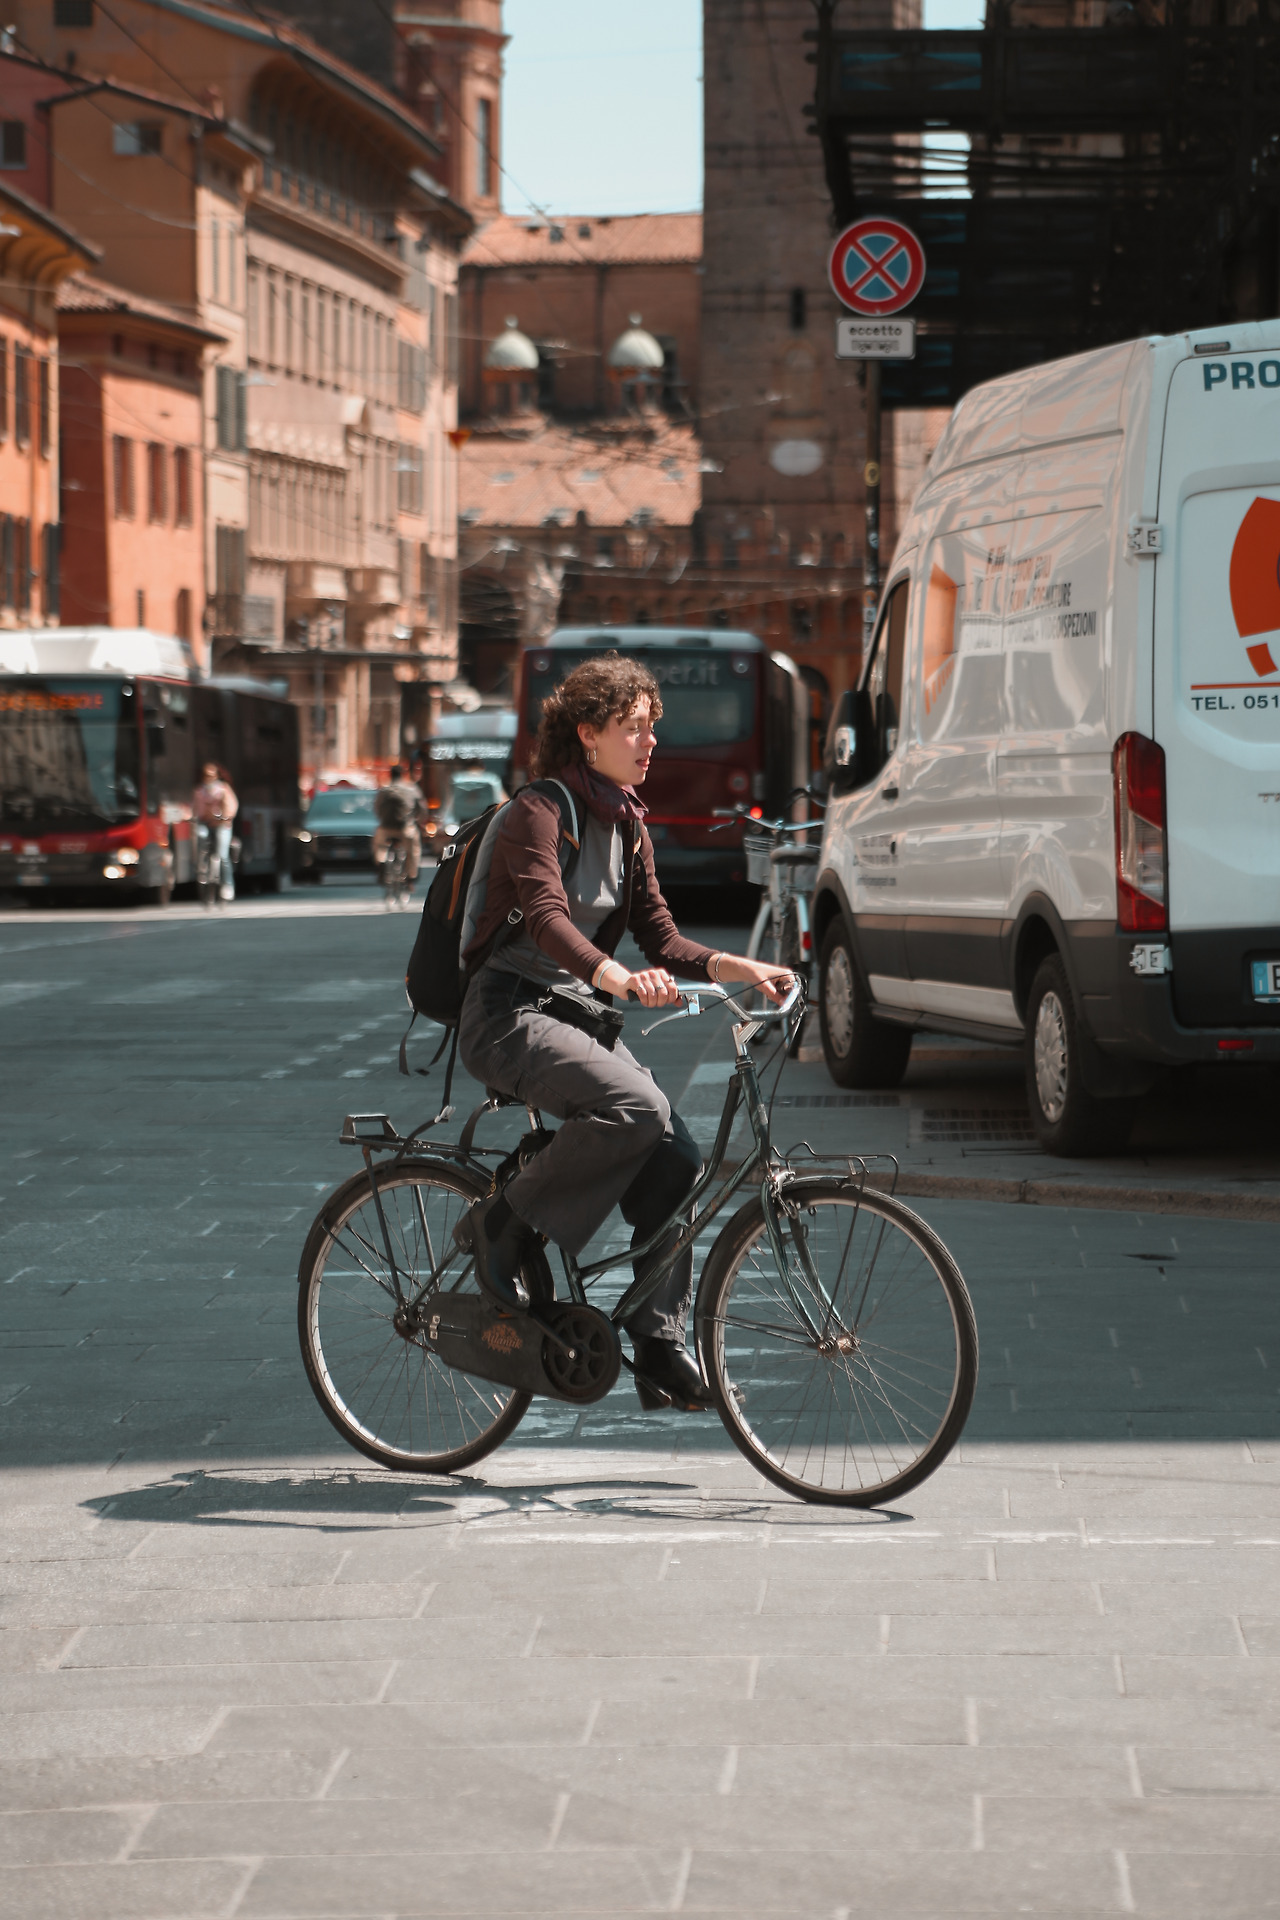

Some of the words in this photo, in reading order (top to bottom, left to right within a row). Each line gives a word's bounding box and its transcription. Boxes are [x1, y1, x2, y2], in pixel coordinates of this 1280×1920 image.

[849, 325, 902, 336] eccetto
[1203, 360, 1280, 391] PRO
[1191, 696, 1235, 711] TEL.
[1243, 695, 1280, 710] 051
